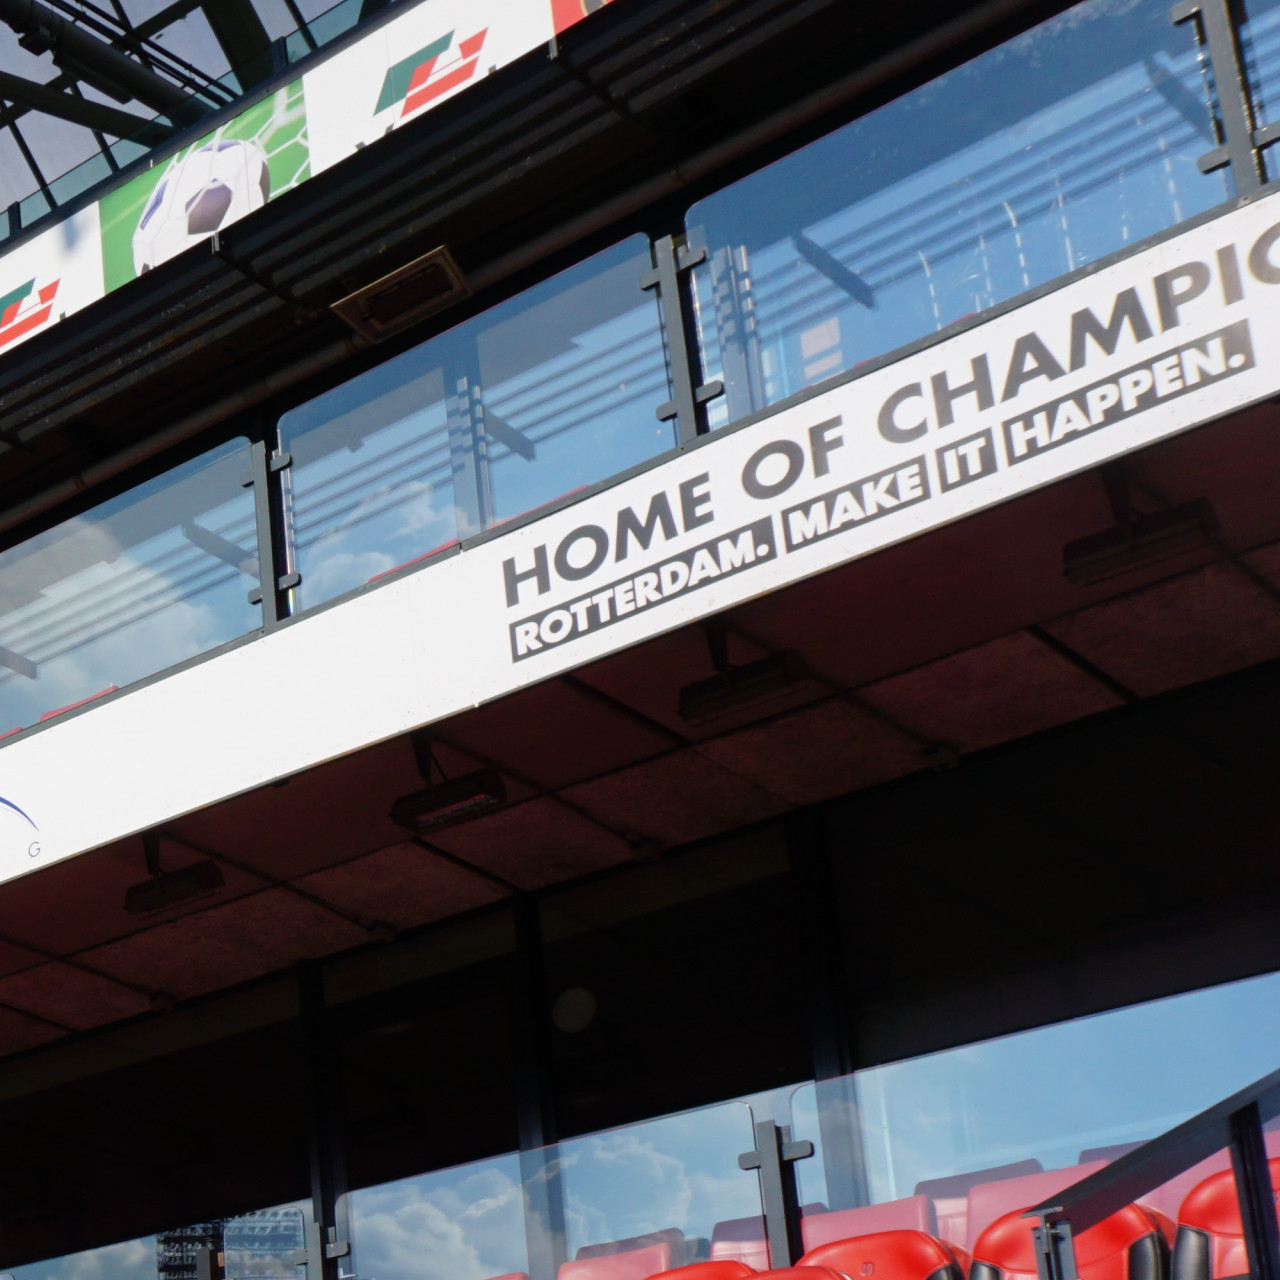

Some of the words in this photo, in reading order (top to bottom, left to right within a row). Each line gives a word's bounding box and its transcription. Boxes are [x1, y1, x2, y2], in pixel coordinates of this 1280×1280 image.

[501, 470, 715, 609] HOME
[739, 414, 844, 501] OF
[513, 528, 770, 659] ROTTERDAM.
[789, 463, 926, 548] MAKE
[942, 438, 988, 487] IT
[1011, 334, 1246, 459] HAPPEN.
